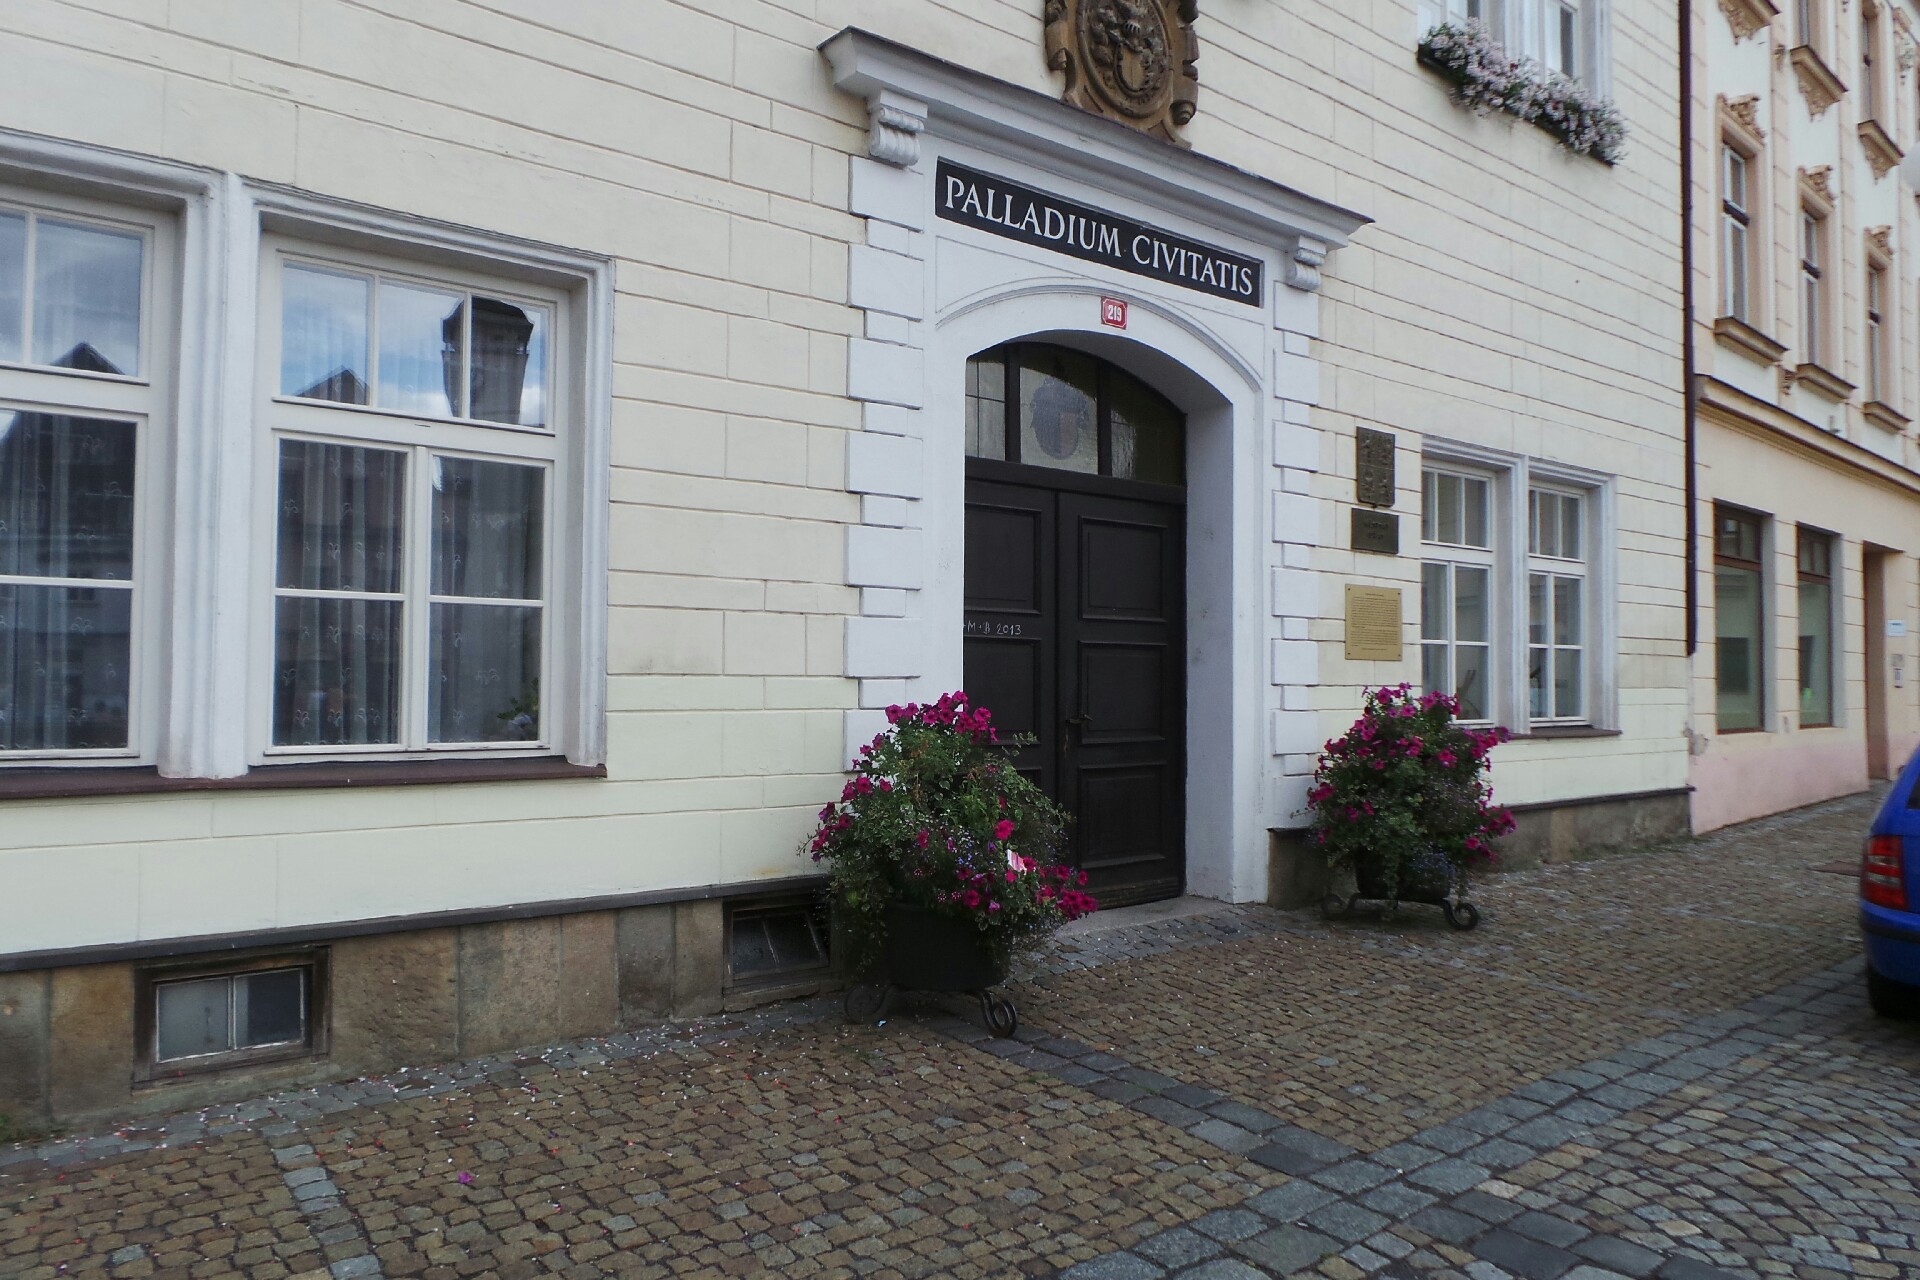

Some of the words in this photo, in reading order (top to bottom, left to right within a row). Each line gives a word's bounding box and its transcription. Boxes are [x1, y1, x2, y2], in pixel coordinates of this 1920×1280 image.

[945, 175, 1122, 258] PALLADIUM
[1132, 234, 1253, 296] CIVITATIS
[1107, 304, 1122, 322] 219
[996, 623, 1022, 636] 2013
